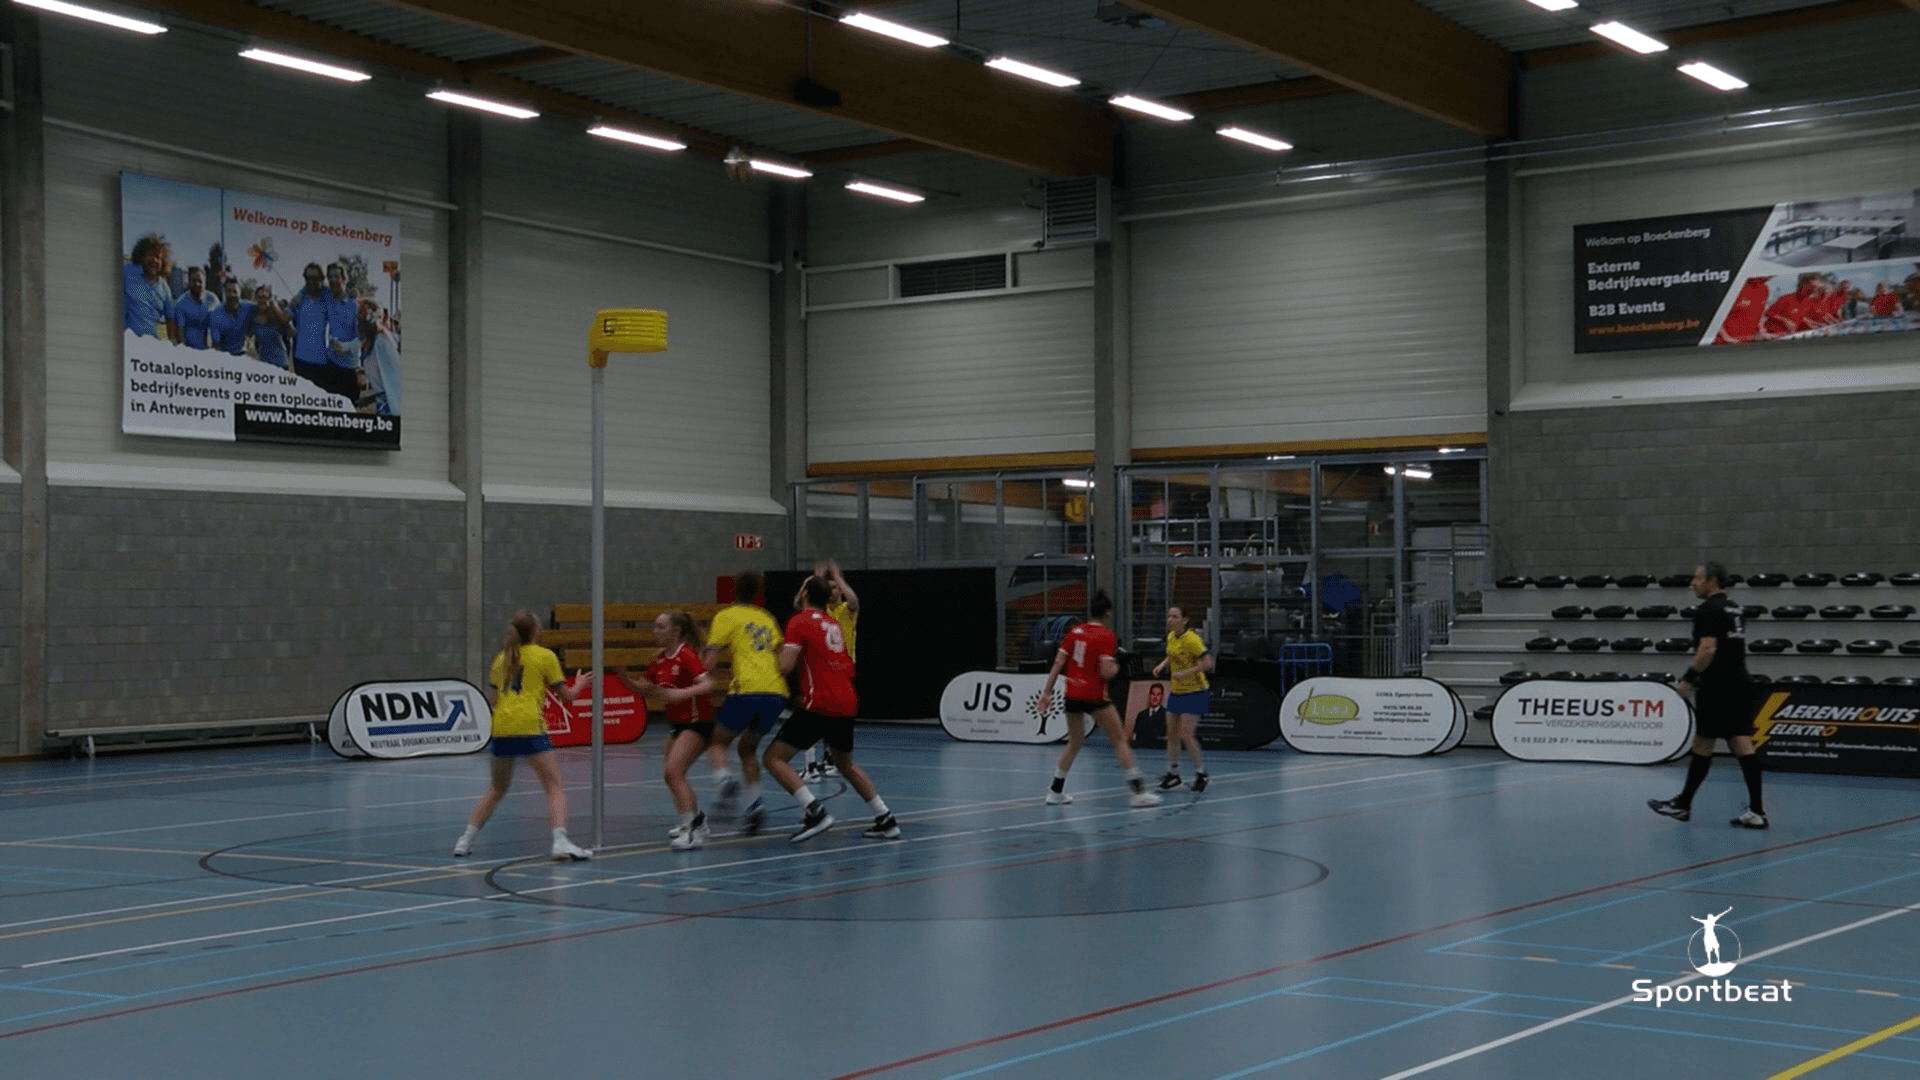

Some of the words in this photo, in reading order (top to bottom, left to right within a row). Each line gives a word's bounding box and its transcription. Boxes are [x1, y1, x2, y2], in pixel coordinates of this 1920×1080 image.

[233, 206, 289, 230] Welkom
[291, 219, 309, 234] op
[311, 219, 393, 246] Boeckenberg
[1586, 235, 1626, 248] Welkom
[1627, 235, 1641, 247] op
[1643, 228, 1711, 243] Boeckenberg
[1587, 259, 1641, 275] Externe
[1587, 268, 1731, 292] Bedrijfsvergadering
[1588, 303, 1616, 317] B2B
[1618, 300, 1666, 316] Events
[1588, 318, 1701, 336] www.boeckenberg.be
[130, 358, 243, 384] Totaaloplossing
[245, 371, 276, 386] voor
[279, 375, 298, 387] uw
[130, 379, 230, 401] bedrijfsevents
[234, 390, 251, 406] op
[254, 391, 278, 404] een
[280, 392, 344, 409] toplocatie
[130, 400, 146, 414] in
[149, 401, 226, 420] Antwerpen
[245, 408, 393, 432] www.boeckenberg.be
[360, 691, 438, 723] NDN
[963, 682, 1013, 713] JIS
[1774, 705, 1920, 723] AERENHOUTS
[1546, 719, 1664, 730] VERZEKERINGSKANTOOR
[1769, 724, 1838, 737] ELEKTRO
[370, 739, 401, 750] NEUTRAAL
